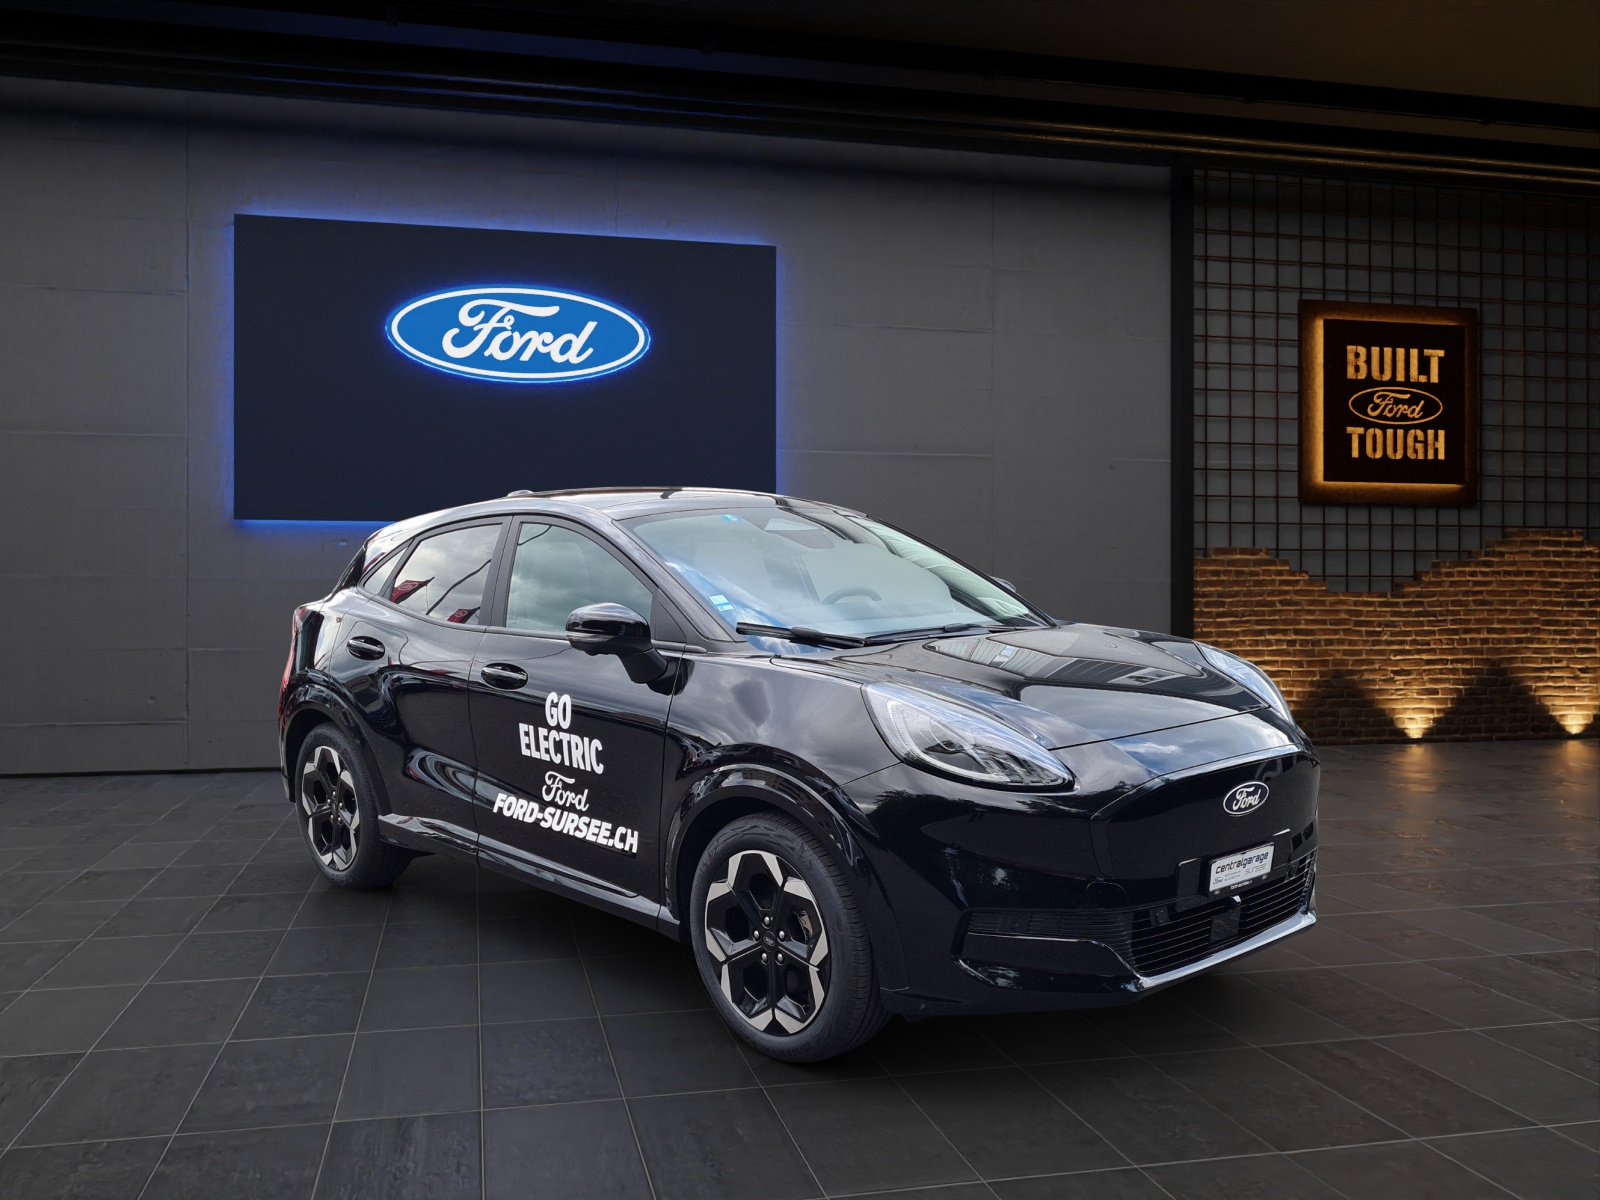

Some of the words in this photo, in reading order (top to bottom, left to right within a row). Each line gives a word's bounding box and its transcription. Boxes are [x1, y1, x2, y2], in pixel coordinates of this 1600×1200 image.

[442, 299, 598, 364] Ford
[1346, 345, 1445, 383] BUILT
[1367, 391, 1425, 418] Ford
[1346, 426, 1446, 460] TOUGH
[545, 691, 572, 729] GO
[518, 722, 604, 774] ELECTRIC
[542, 771, 589, 812] Ford
[1232, 786, 1262, 811] Ford
[492, 792, 639, 854] FORD-SURSEE.CH
[1215, 852, 1269, 874] centralgarage
